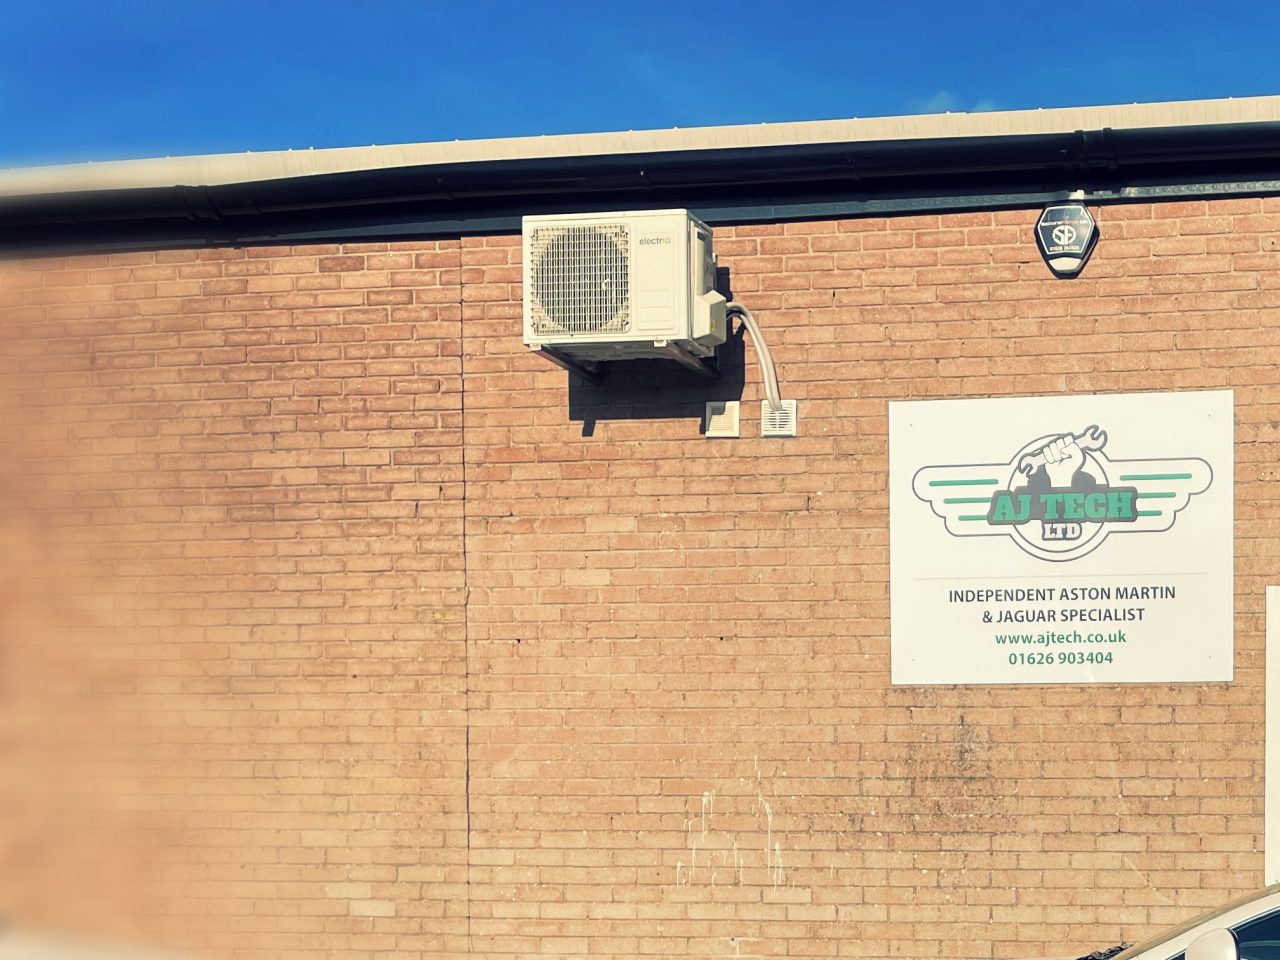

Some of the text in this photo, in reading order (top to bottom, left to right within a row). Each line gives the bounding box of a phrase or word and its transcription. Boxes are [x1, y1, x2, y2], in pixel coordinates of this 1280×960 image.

[992, 491, 1133, 521] AJ TECH
[1044, 523, 1081, 540] LTD
[949, 586, 1176, 603] INDEPENDENT ASTON MARTIN
[982, 608, 1145, 623] & JAGUAR SPECIALIST
[995, 629, 1127, 647] www.ajtech.co.uk
[1008, 651, 1113, 665] 01626 903404
